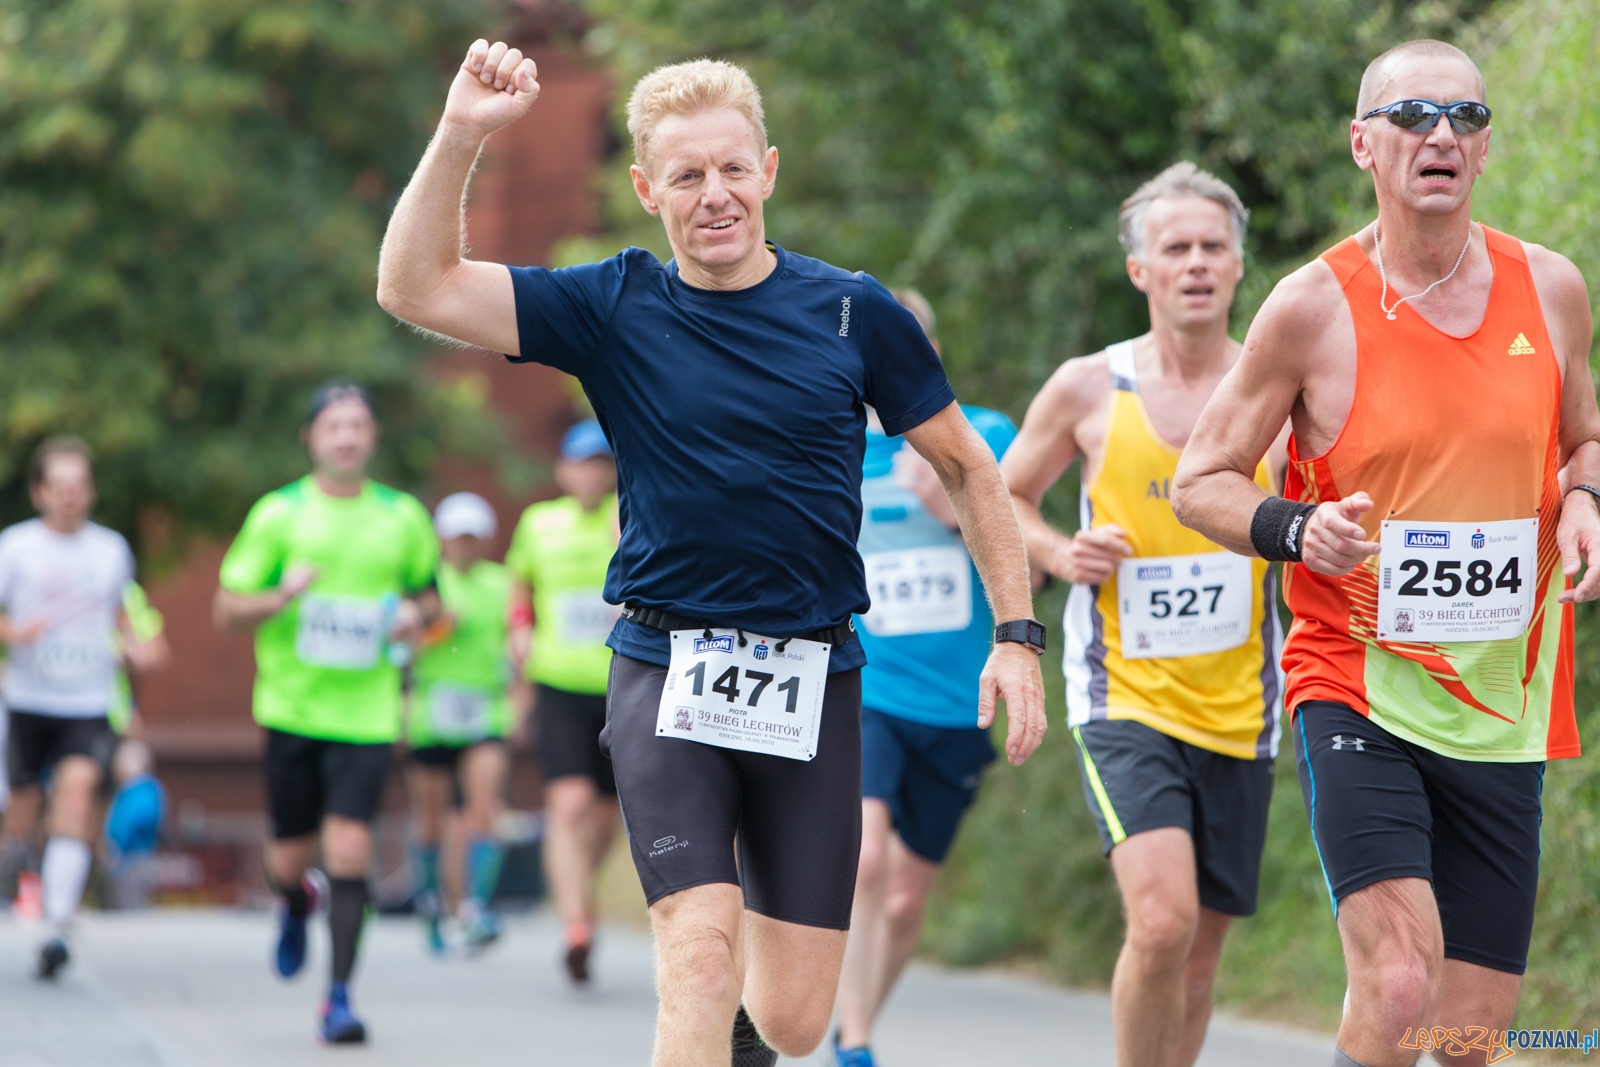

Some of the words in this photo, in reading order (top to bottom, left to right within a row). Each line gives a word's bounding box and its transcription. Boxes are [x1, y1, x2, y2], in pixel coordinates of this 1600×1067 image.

[838, 296, 851, 337] Reebok
[1508, 347, 1536, 356] adidas
[1397, 557, 1522, 597] 2584
[1150, 584, 1224, 619] 527
[1418, 609, 1434, 621] 39
[1437, 609, 1466, 620] BIEG
[1468, 604, 1523, 620] LECHITÓW
[771, 650, 786, 659] Bank
[787, 652, 805, 661] Polski
[684, 661, 800, 713] 1471
[728, 707, 748, 717] PIOTR
[697, 710, 711, 722] 39
[713, 713, 740, 727] BIEG
[743, 719, 803, 737] LECHITÓW
[718, 732, 743, 742] GNIEZNO,
